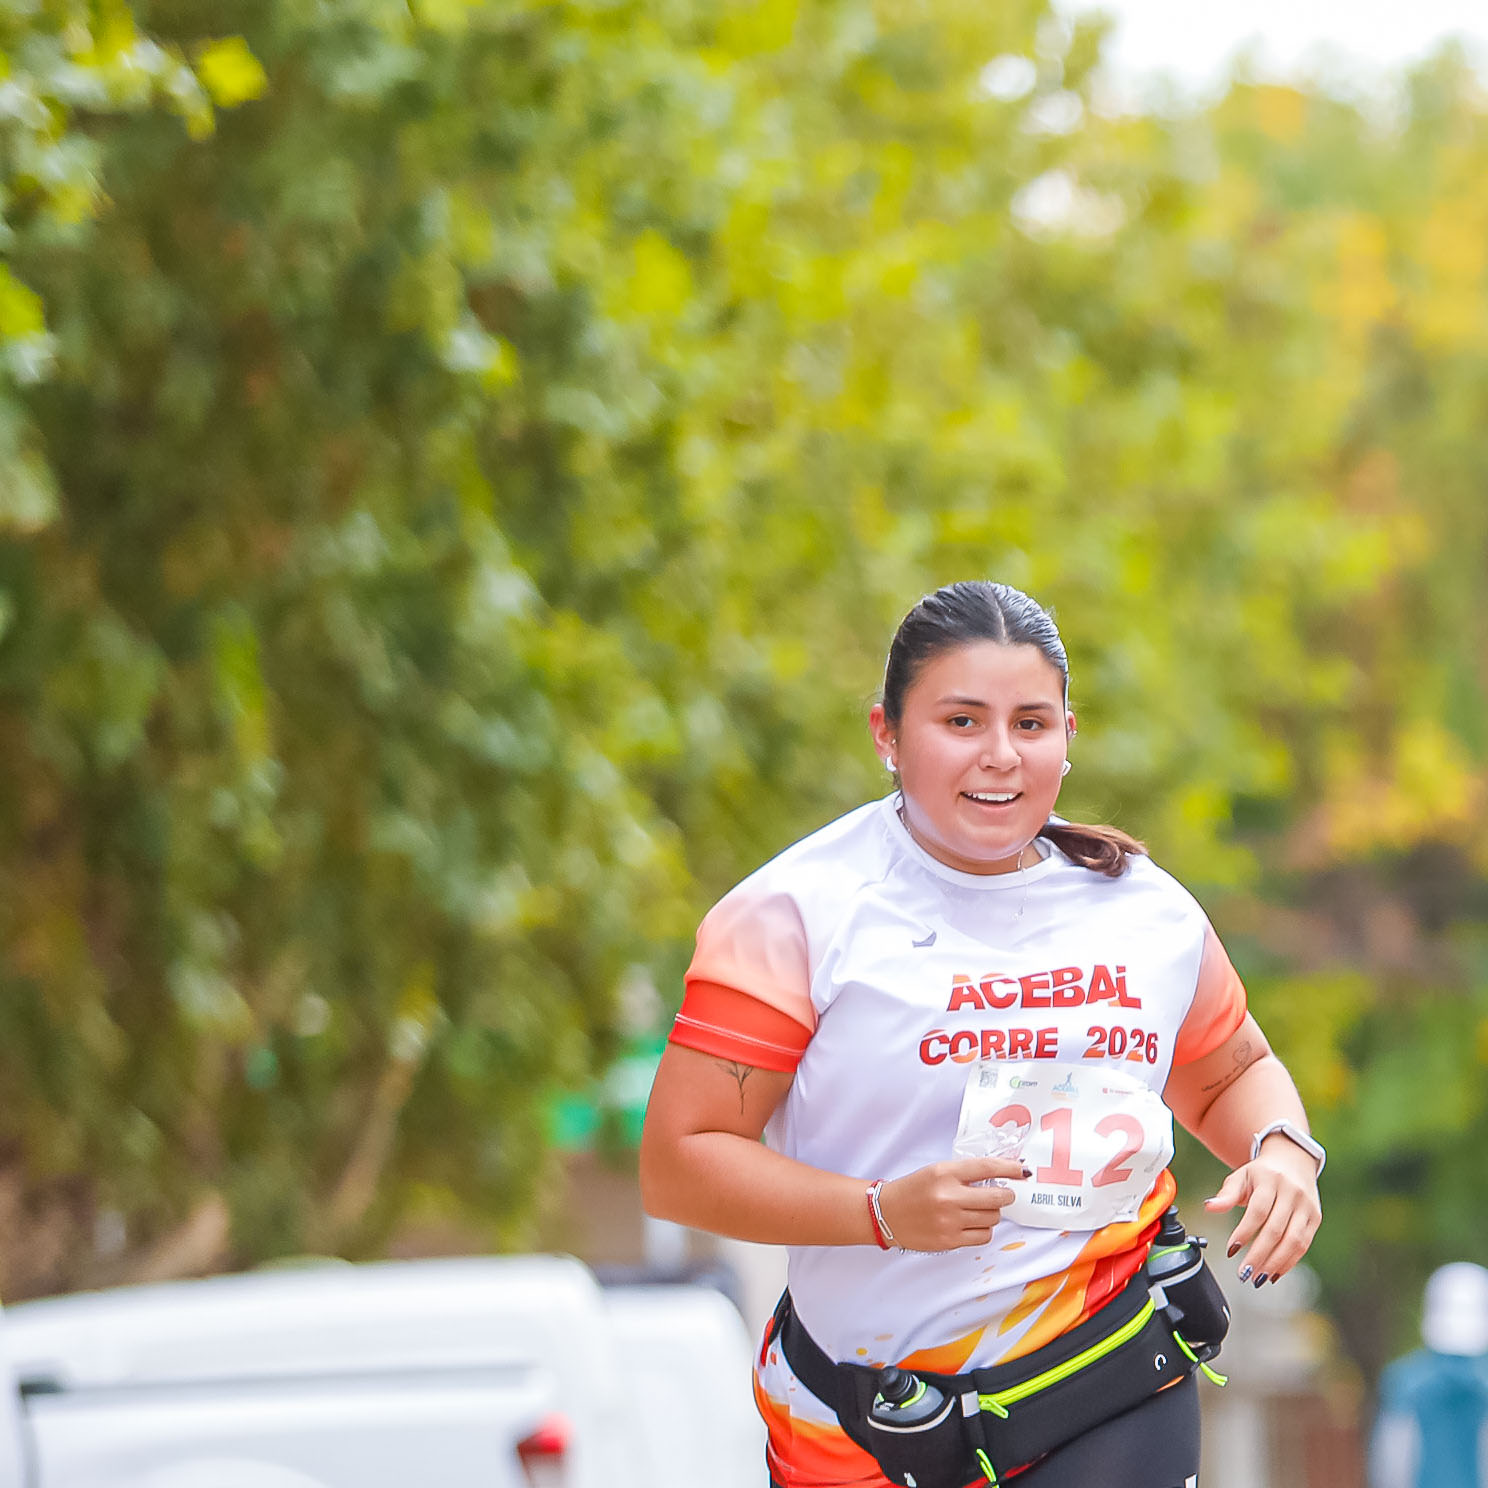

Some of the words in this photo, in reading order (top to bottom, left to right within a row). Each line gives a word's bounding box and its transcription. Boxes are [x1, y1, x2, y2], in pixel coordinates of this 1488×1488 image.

[946, 964, 1142, 1011] ACEBAL
[919, 1027, 1058, 1066] CORRE
[1082, 1026, 1159, 1065] 2026
[1031, 1193, 1055, 1206] ABRIL
[1057, 1195, 1082, 1208] SILVA
